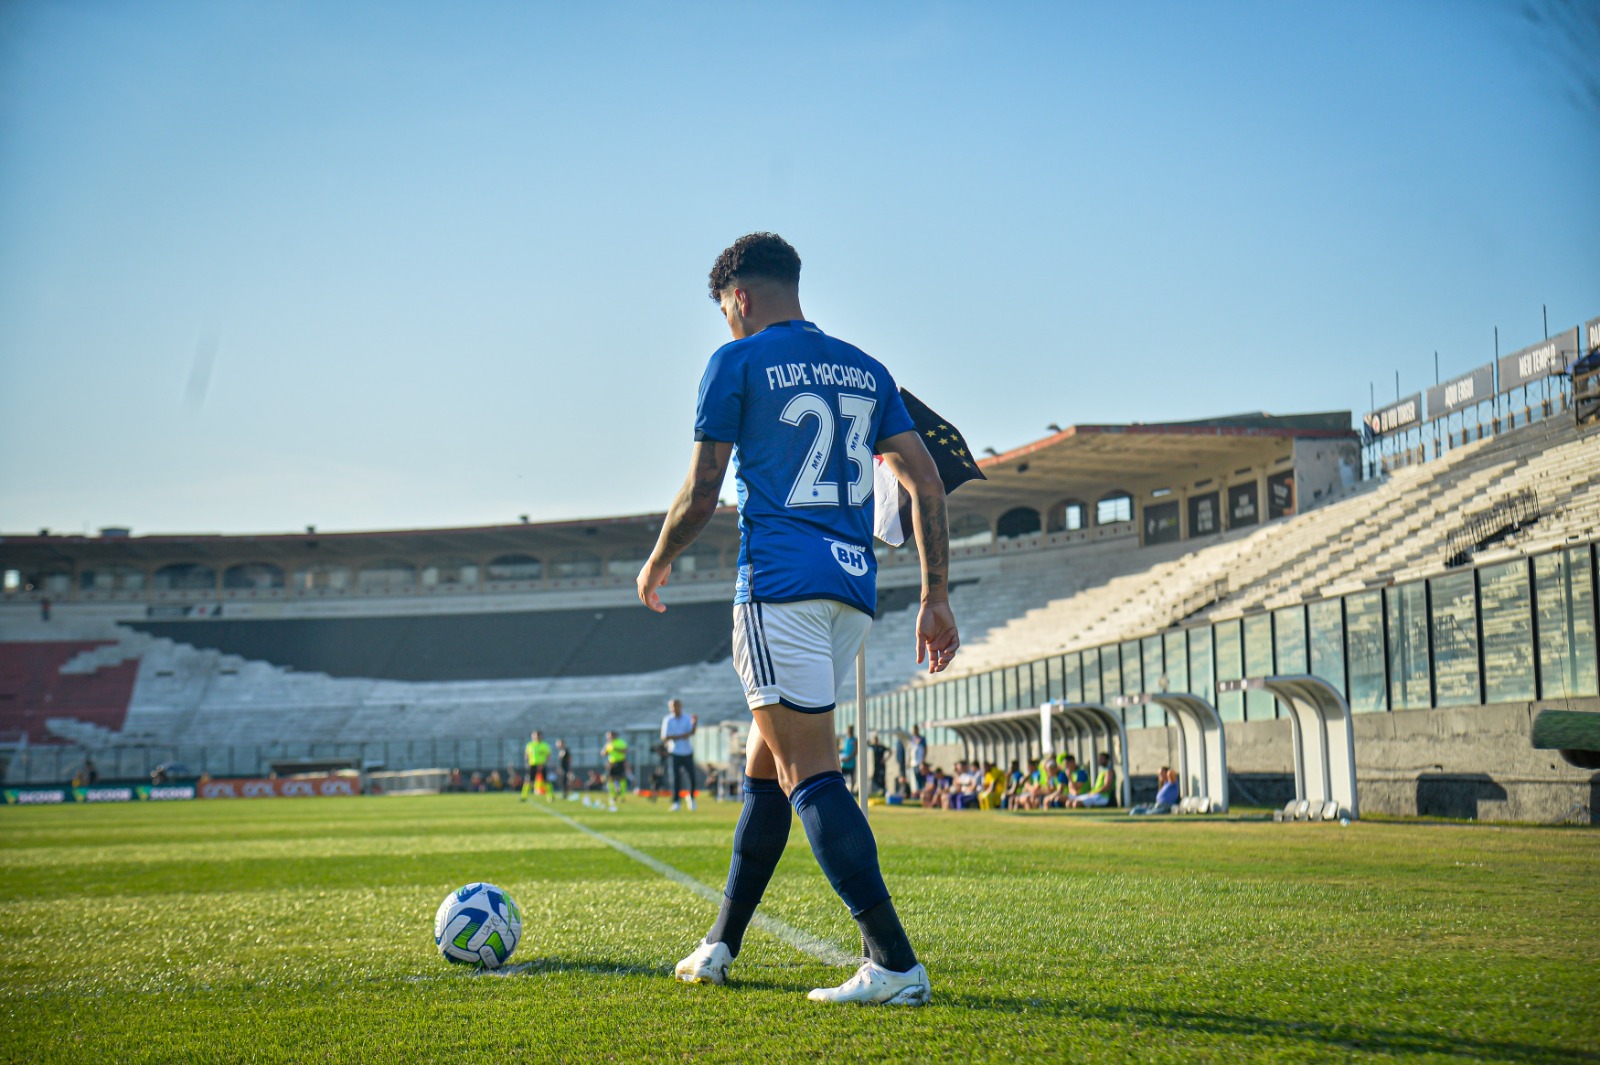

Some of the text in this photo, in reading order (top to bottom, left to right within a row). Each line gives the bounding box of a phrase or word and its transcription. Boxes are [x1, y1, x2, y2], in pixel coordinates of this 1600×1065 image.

[1590, 323, 1600, 348] PA
[766, 363, 877, 392] FILIPE MACHADO
[779, 392, 877, 507] 23
[836, 547, 864, 570] BH
